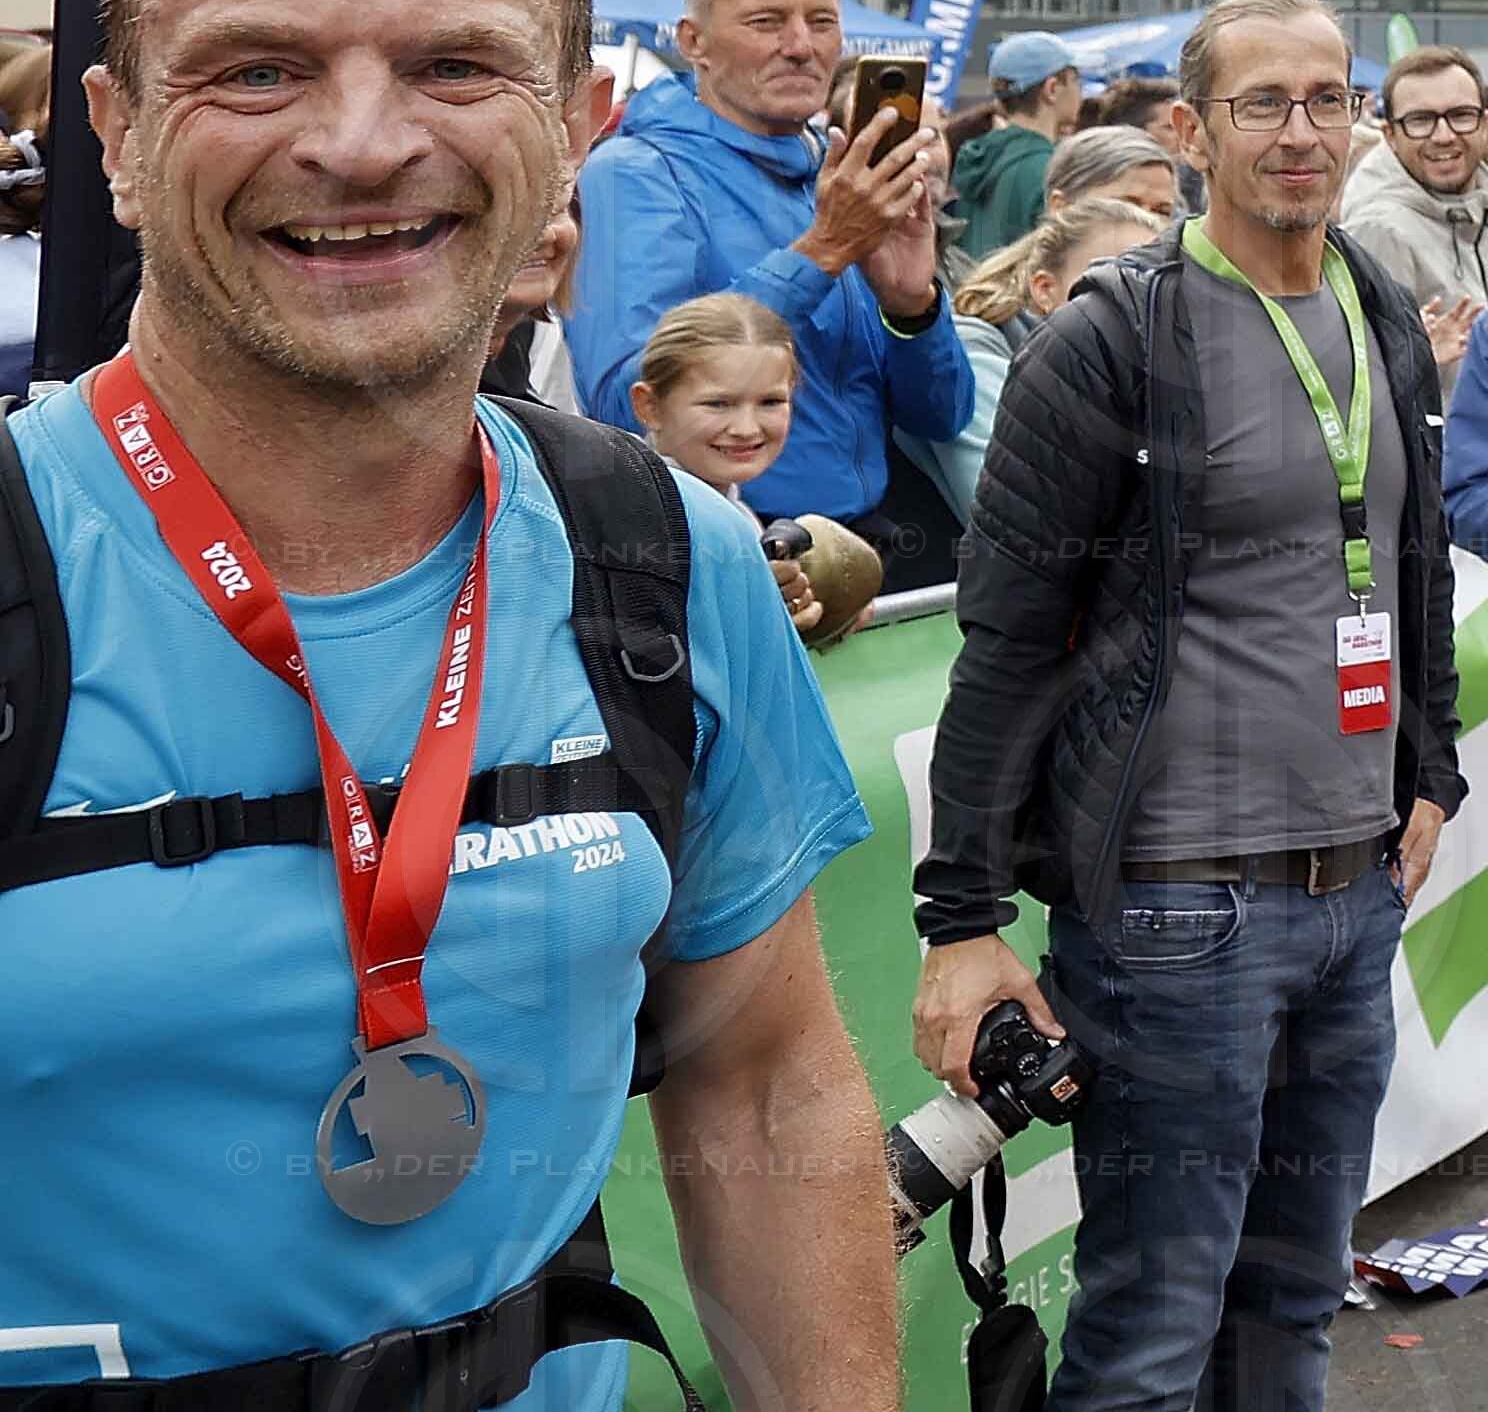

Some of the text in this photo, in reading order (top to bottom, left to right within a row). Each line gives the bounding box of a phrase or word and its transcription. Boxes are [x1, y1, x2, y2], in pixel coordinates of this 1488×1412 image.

[115, 405, 175, 489] GRAZ
[201, 540, 253, 599] 2024
[436, 624, 473, 729] KLEINE
[1343, 685, 1386, 708] MEDIA
[555, 739, 604, 754] KLEINE
[342, 776, 378, 872] GRAZ
[450, 812, 622, 875] RATHON
[571, 840, 625, 874] 2024
